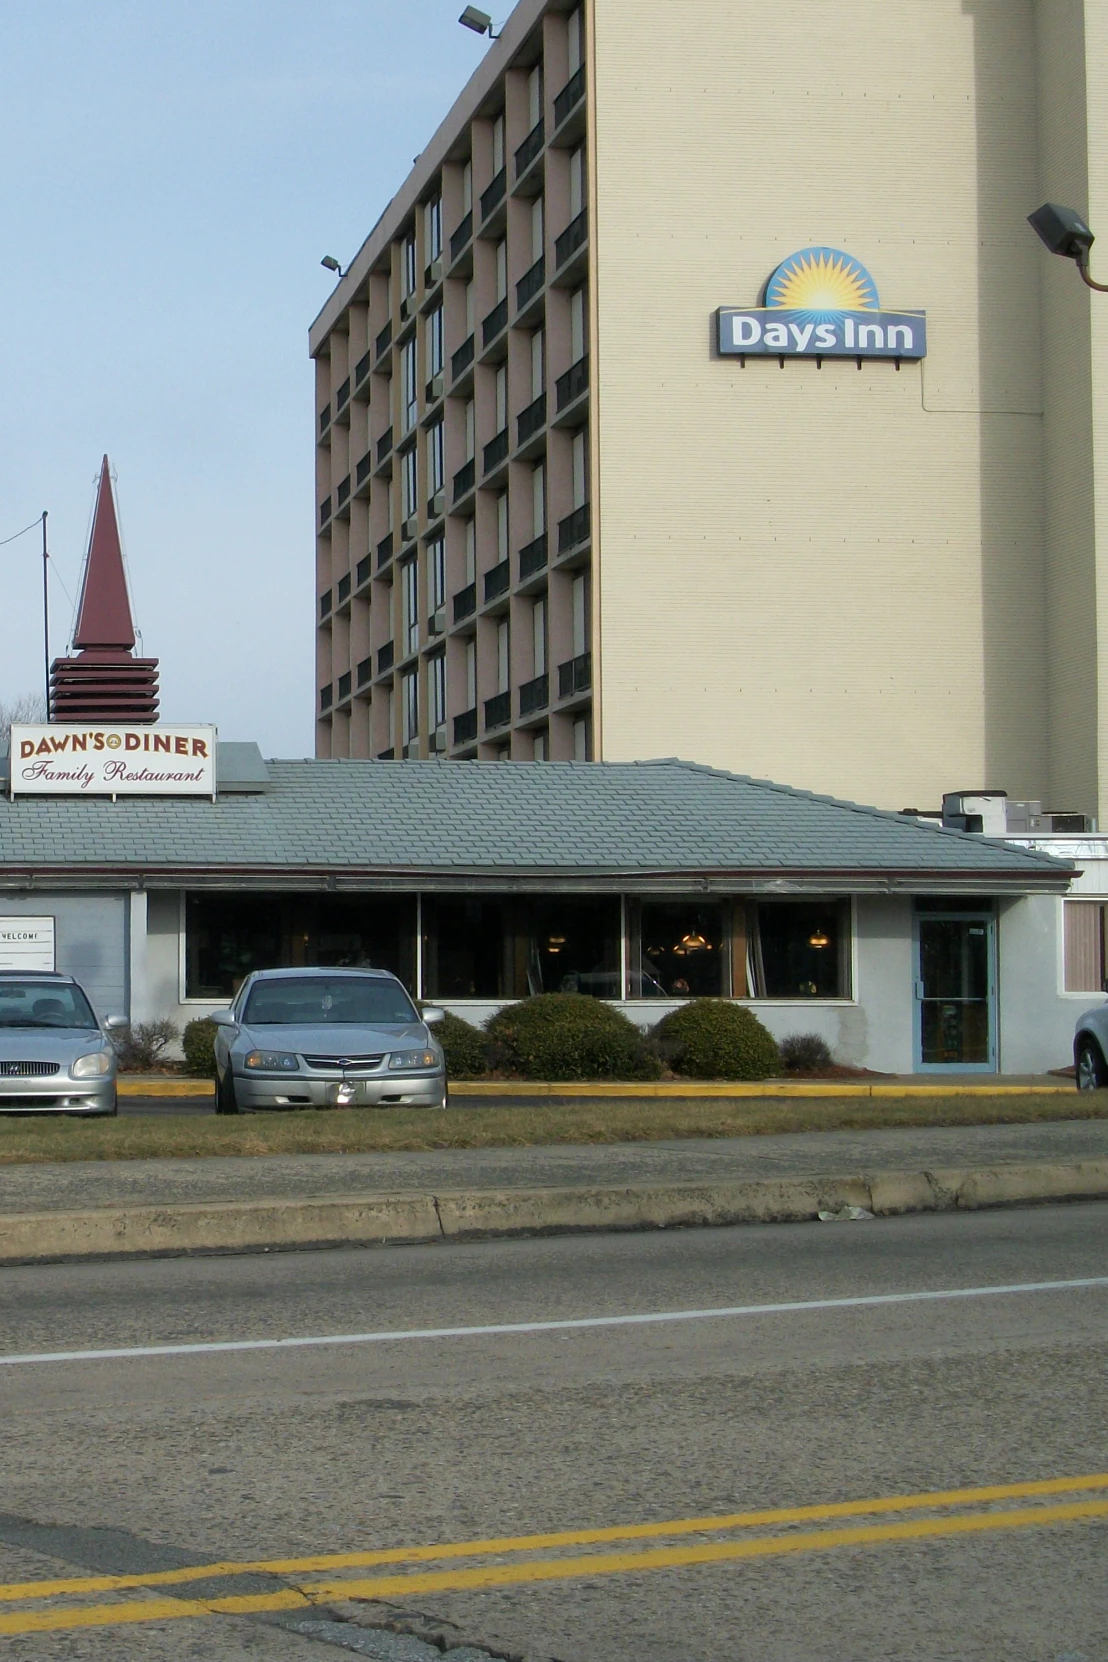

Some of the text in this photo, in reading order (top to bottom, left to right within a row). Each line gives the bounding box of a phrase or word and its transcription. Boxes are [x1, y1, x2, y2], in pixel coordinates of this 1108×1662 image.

[732, 315, 914, 352] Days Inn
[20, 731, 209, 760] DAWN'S DINER
[21, 760, 205, 788] Family Restaurant
